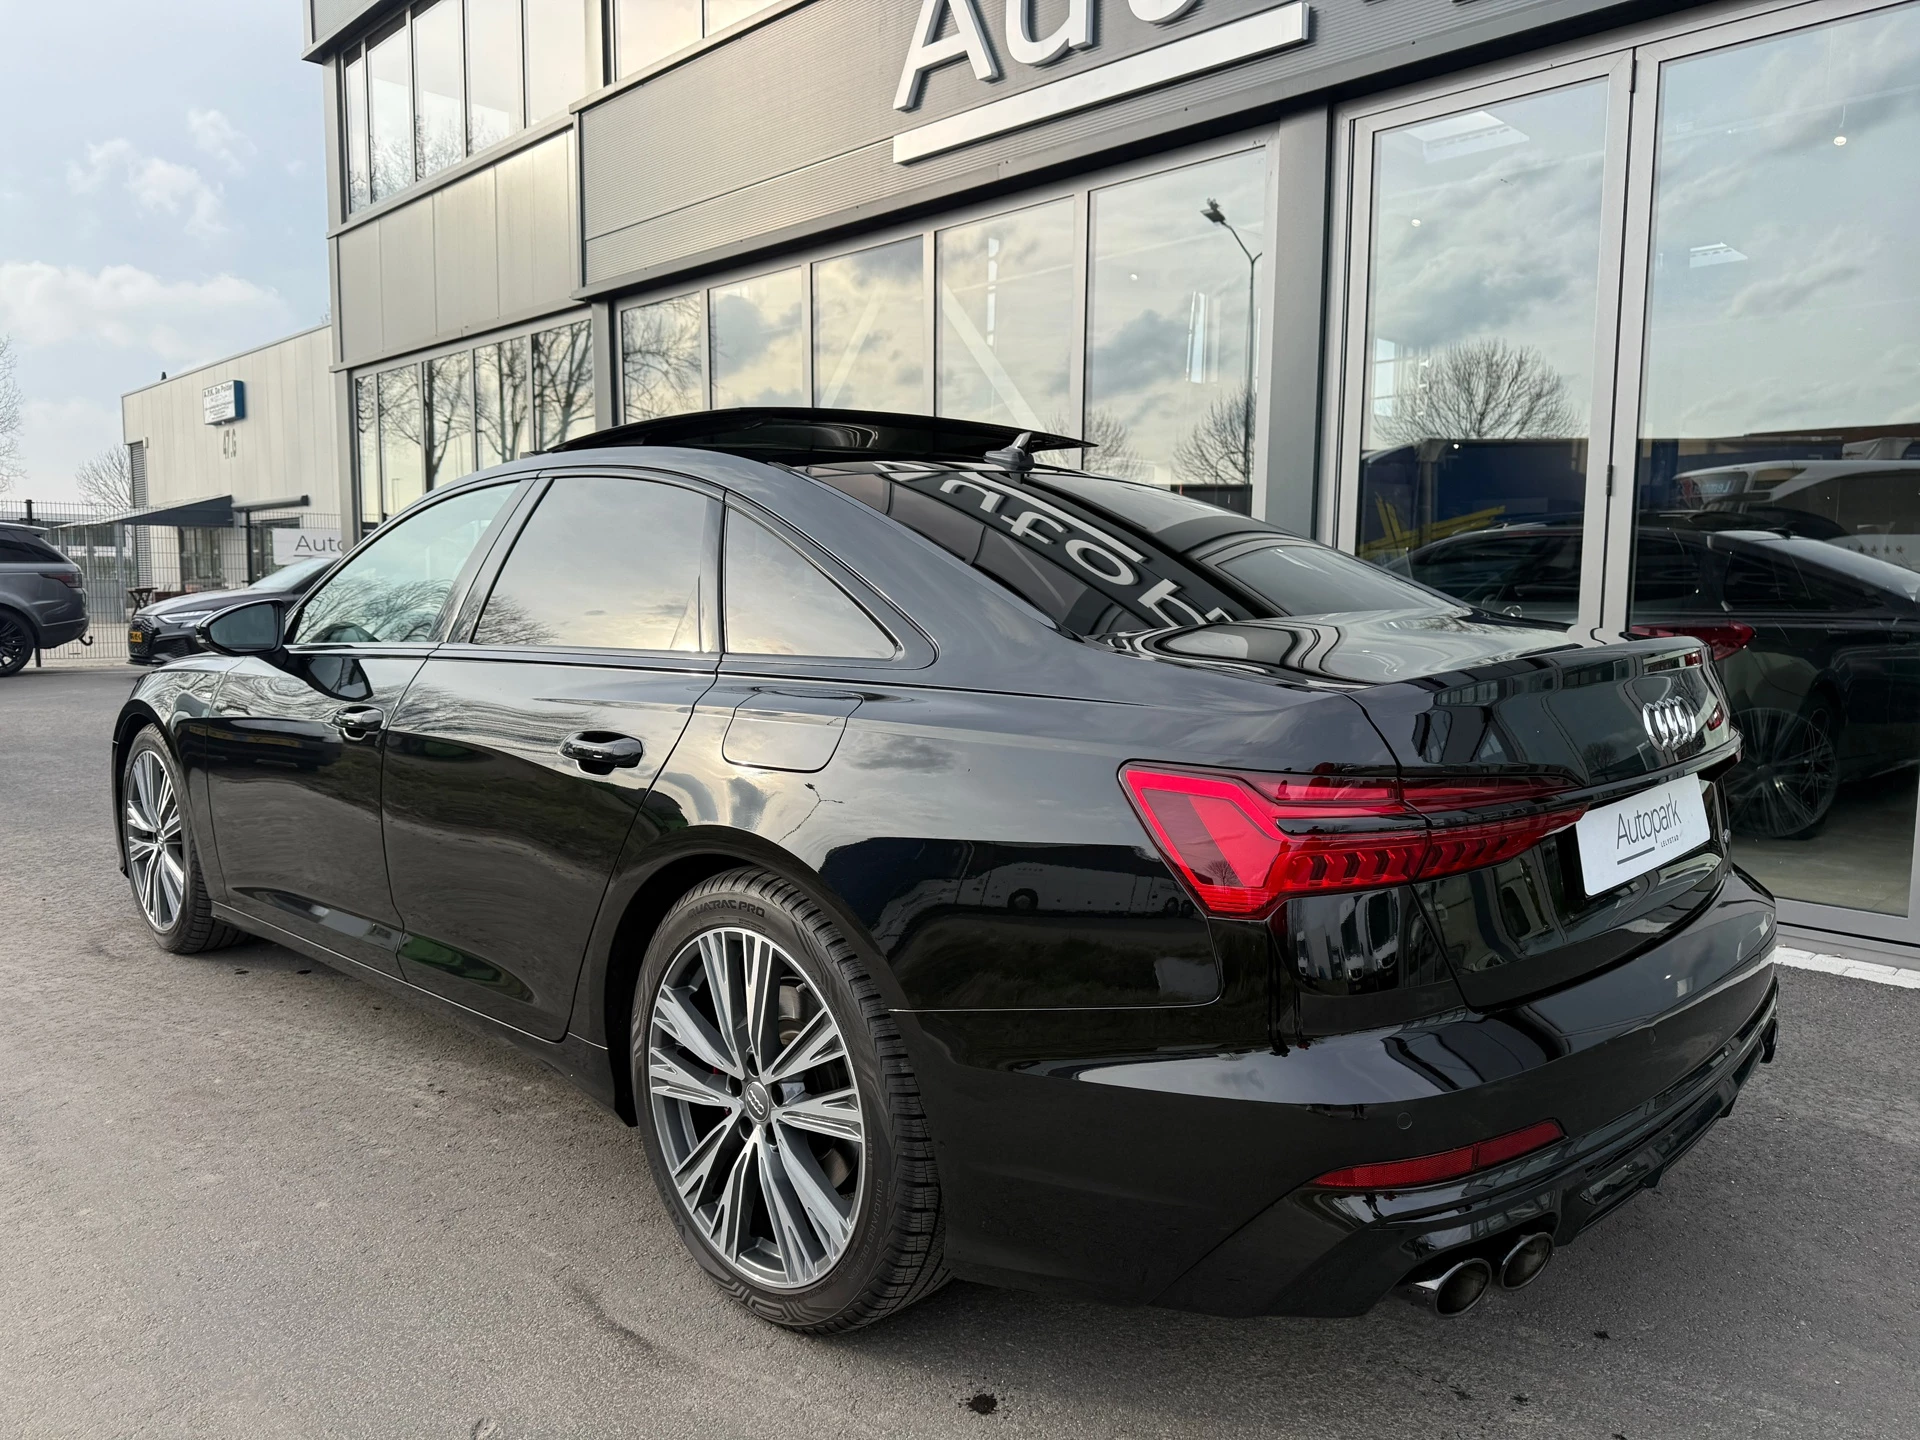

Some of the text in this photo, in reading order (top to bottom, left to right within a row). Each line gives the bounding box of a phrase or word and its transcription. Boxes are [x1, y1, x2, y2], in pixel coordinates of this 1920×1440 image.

[1616, 793, 1683, 850] Autopark
[1660, 834, 1680, 848] LELYSTAD
[738, 900, 766, 918] PRO
